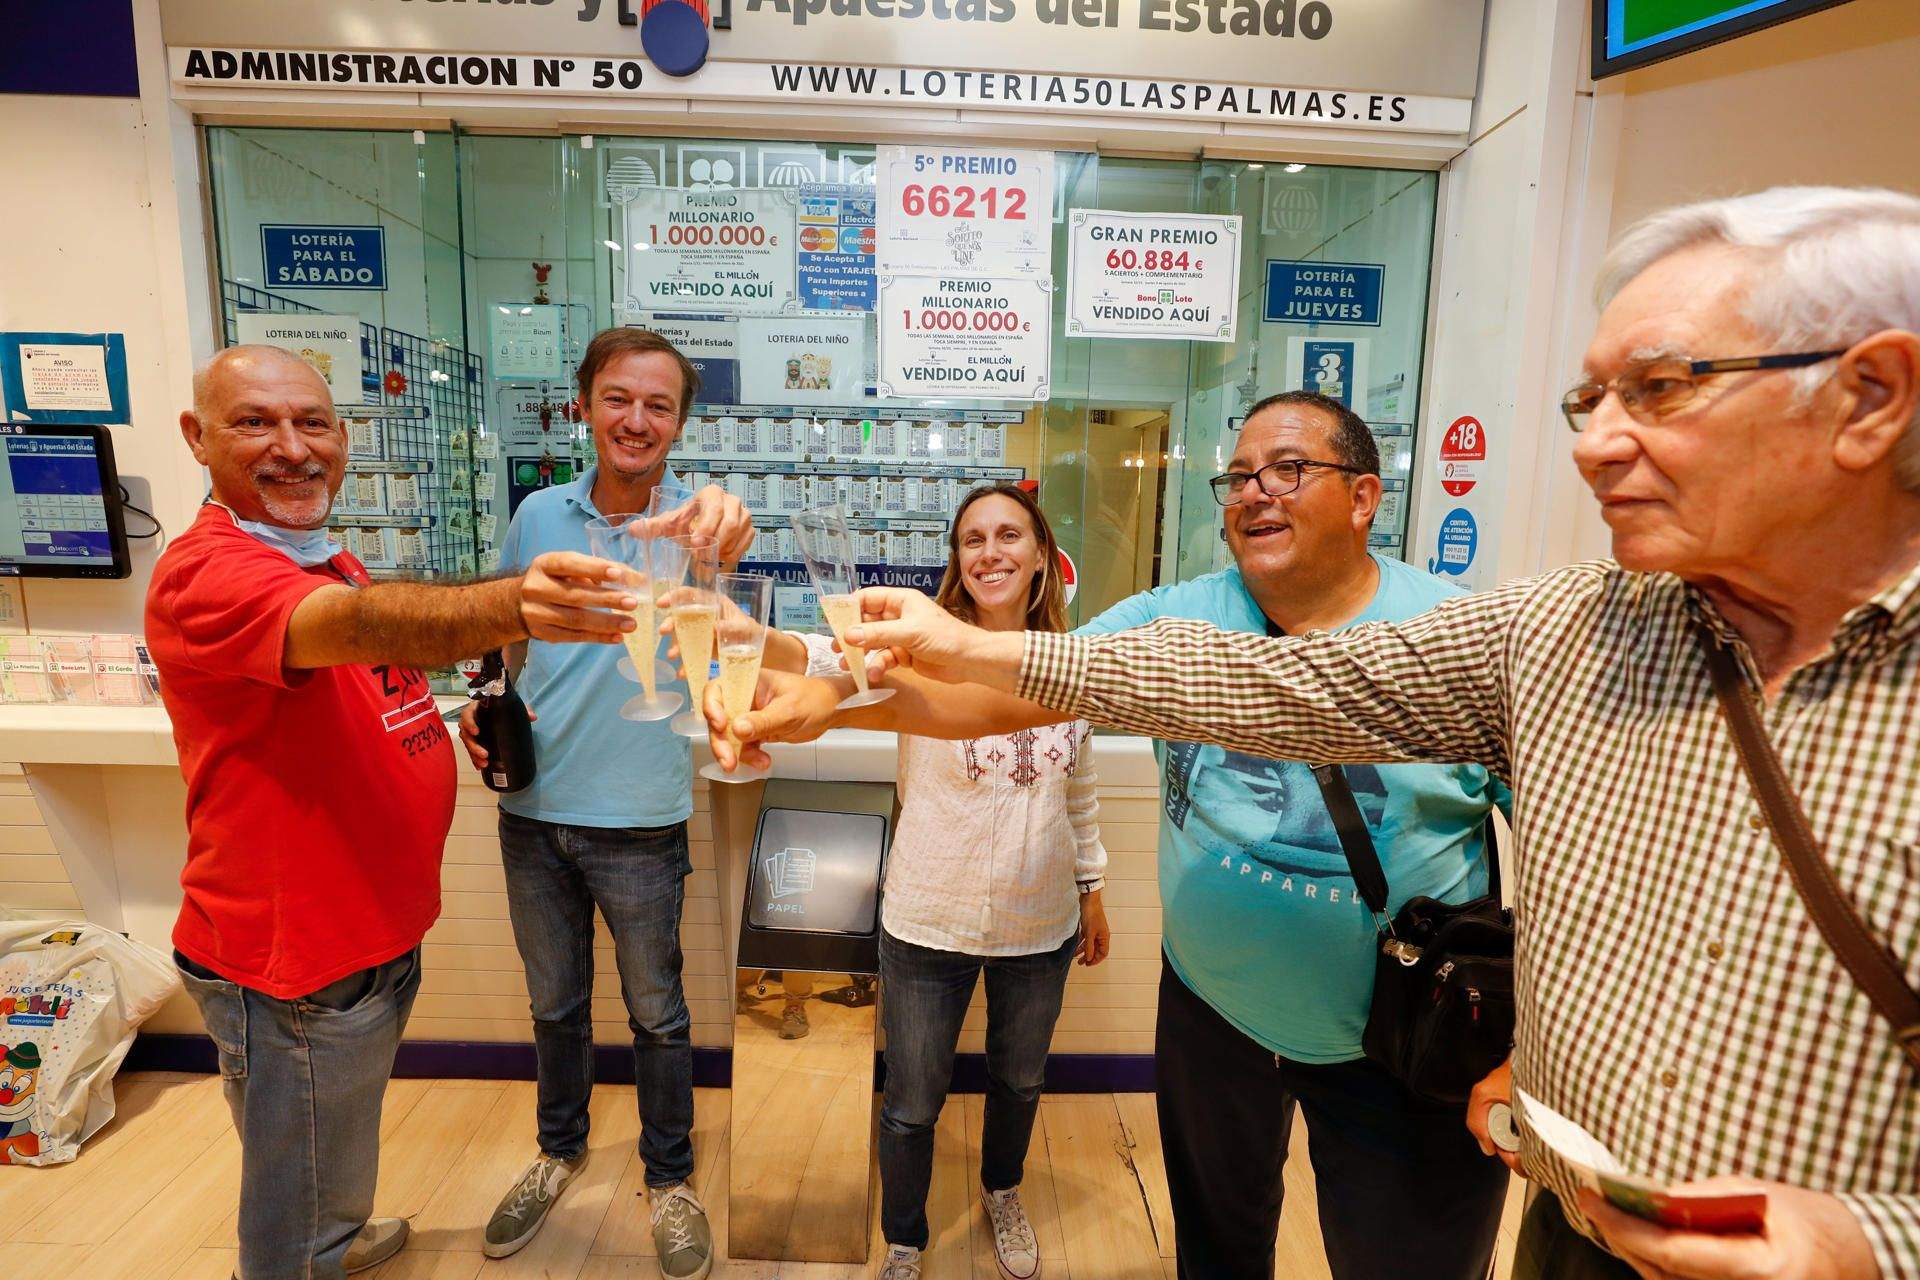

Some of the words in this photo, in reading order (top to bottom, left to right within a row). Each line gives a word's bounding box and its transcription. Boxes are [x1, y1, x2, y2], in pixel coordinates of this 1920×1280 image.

[1138, 0, 1333, 40] Estado
[184, 49, 518, 86] ADMINISTRACION
[592, 61, 643, 90] 50
[771, 65, 1407, 122] WWW.LOTERIA50LASPALMAS.ES
[942, 155, 1017, 176] PREMIO
[902, 184, 1027, 220] 66212
[668, 211, 754, 224] MILLONARIO
[291, 232, 355, 246] LOTERÍA
[649, 224, 765, 246] 1.000.000
[769, 236, 778, 246] €
[1090, 226, 1143, 243] GRAN
[1150, 229, 1218, 245] PREMIO
[293, 250, 334, 261] PARA
[340, 251, 356, 262] EL
[824, 255, 854, 264] Acepta
[1106, 248, 1190, 271] 60.884
[1195, 260, 1203, 270] €
[278, 262, 374, 283] SÁBADO
[1295, 269, 1356, 283] LOTERÍA
[650, 282, 724, 296] VENDIDO
[730, 281, 774, 298] AQUÍ
[830, 277, 868, 286] Importes
[940, 280, 992, 292] PREMIO
[812, 288, 859, 297] Superiores
[1295, 286, 1334, 297] PARA
[1340, 287, 1355, 298] EL
[922, 297, 1008, 309] MILLONARIO
[1284, 302, 1363, 319] JUEVES
[903, 310, 1018, 332] 1.000.000
[1022, 322, 1030, 332] €
[1093, 306, 1164, 320] VENDIDO
[1170, 306, 1210, 322] AQUÍ
[266, 330, 302, 339] LOTERIA
[305, 331, 321, 339] DEL
[324, 330, 347, 339] NIÑO
[768, 335, 804, 344] LOTERIA
[807, 335, 823, 344] DEL
[825, 334, 849, 344] NIÑO
[902, 367, 977, 381] VENDIDO
[983, 366, 1025, 382] AQUÍ
[1450, 423, 1477, 450] +18
[884, 566, 933, 587] ÚNICA
[1186, 742, 1198, 758] PRO
[1220, 855, 1361, 904] APPAREL
[767, 903, 805, 914] PAPEL
